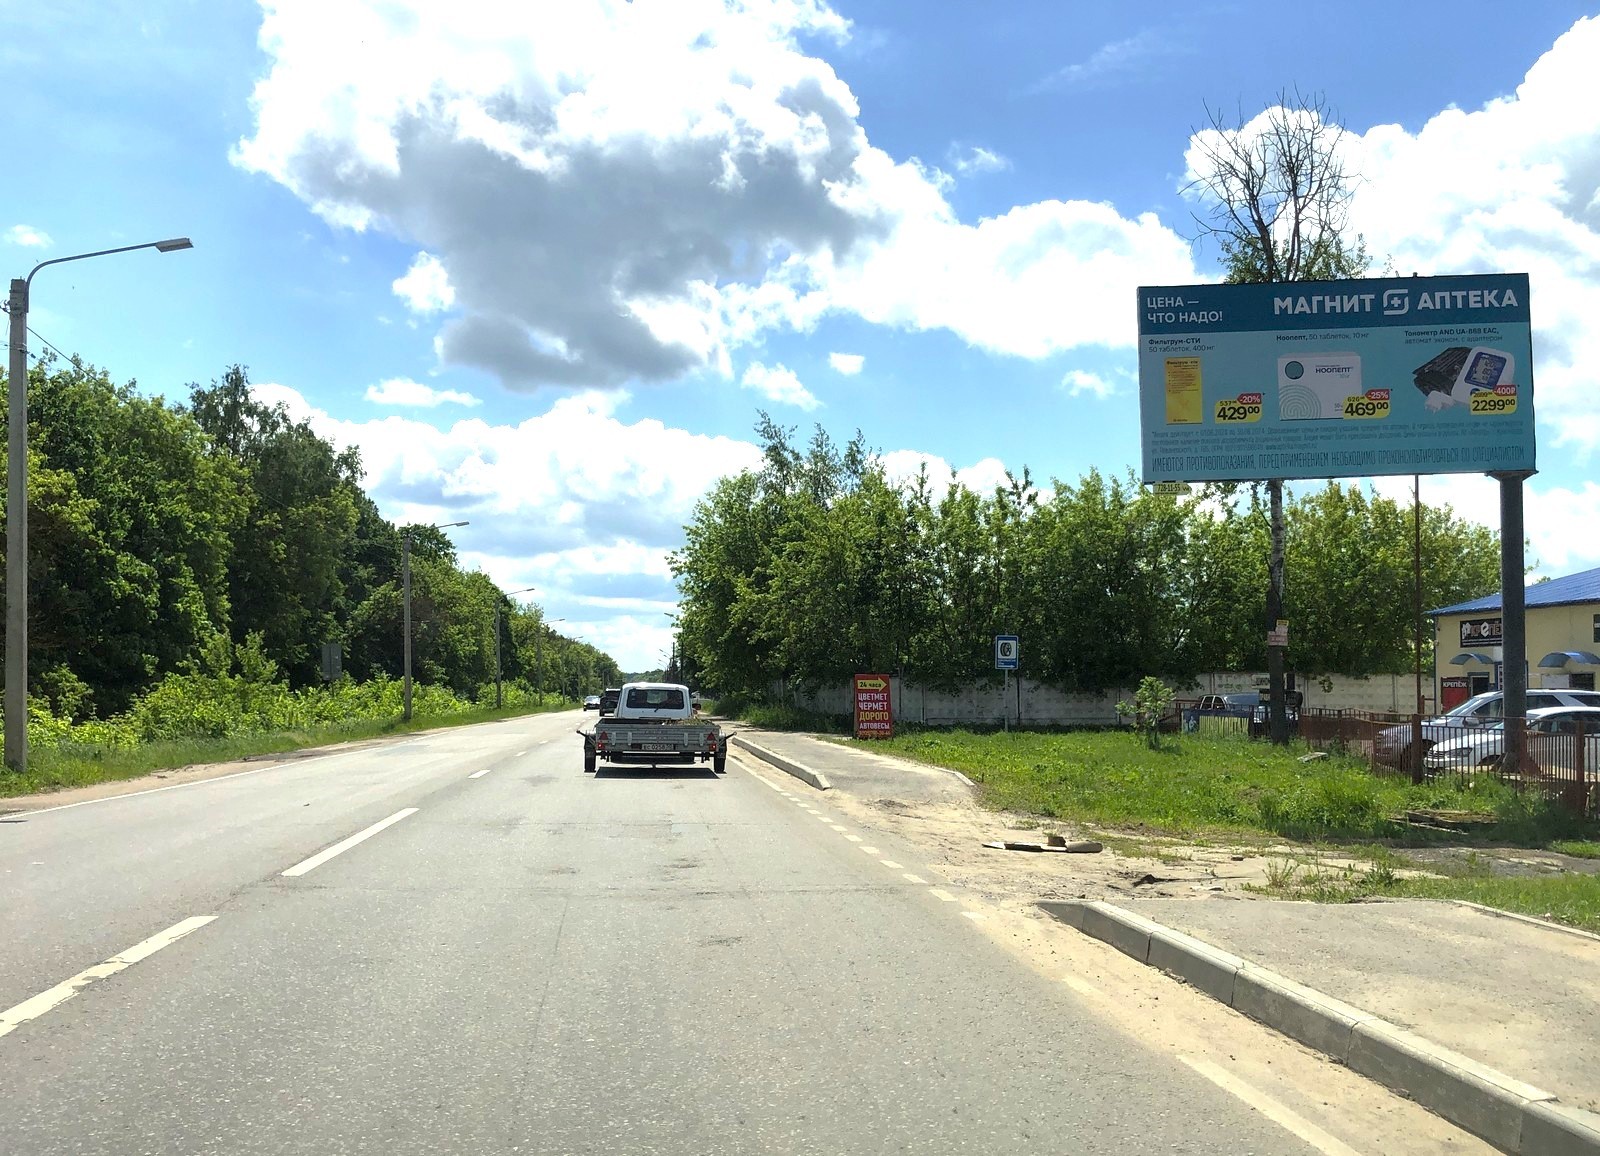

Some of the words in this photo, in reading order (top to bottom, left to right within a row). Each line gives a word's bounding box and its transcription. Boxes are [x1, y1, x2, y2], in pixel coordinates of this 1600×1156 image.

[1147, 297, 1184, 309] ЦЕНА
[1274, 294, 1375, 315] МАГНИТ
[1417, 289, 1518, 310] АПТЕКА
[1147, 312, 1175, 324] ЧТО
[1179, 311, 1223, 324] НАДО!
[1404, 329, 1438, 337] Тонометр
[1148, 337, 1201, 345] Фильтрум-СТИ
[1240, 395, 1260, 403] -20%
[1368, 391, 1388, 399] -25%
[1152, 456, 1184, 472] ИМЕЮТСЯ
[1259, 453, 1280, 470] ПЕРЕД
[1280, 452, 1329, 468] ПРИМЕНЕНИЕМ
[1331, 450, 1376, 467] НЕОБХОДИМО
[858, 692, 888, 701] ЦВЕТМЕТ
[858, 702, 888, 710] ЧЕРМЕТ
[859, 711, 889, 721] ДОРОГО
[859, 722, 890, 730] АВТОВЕСЫ
